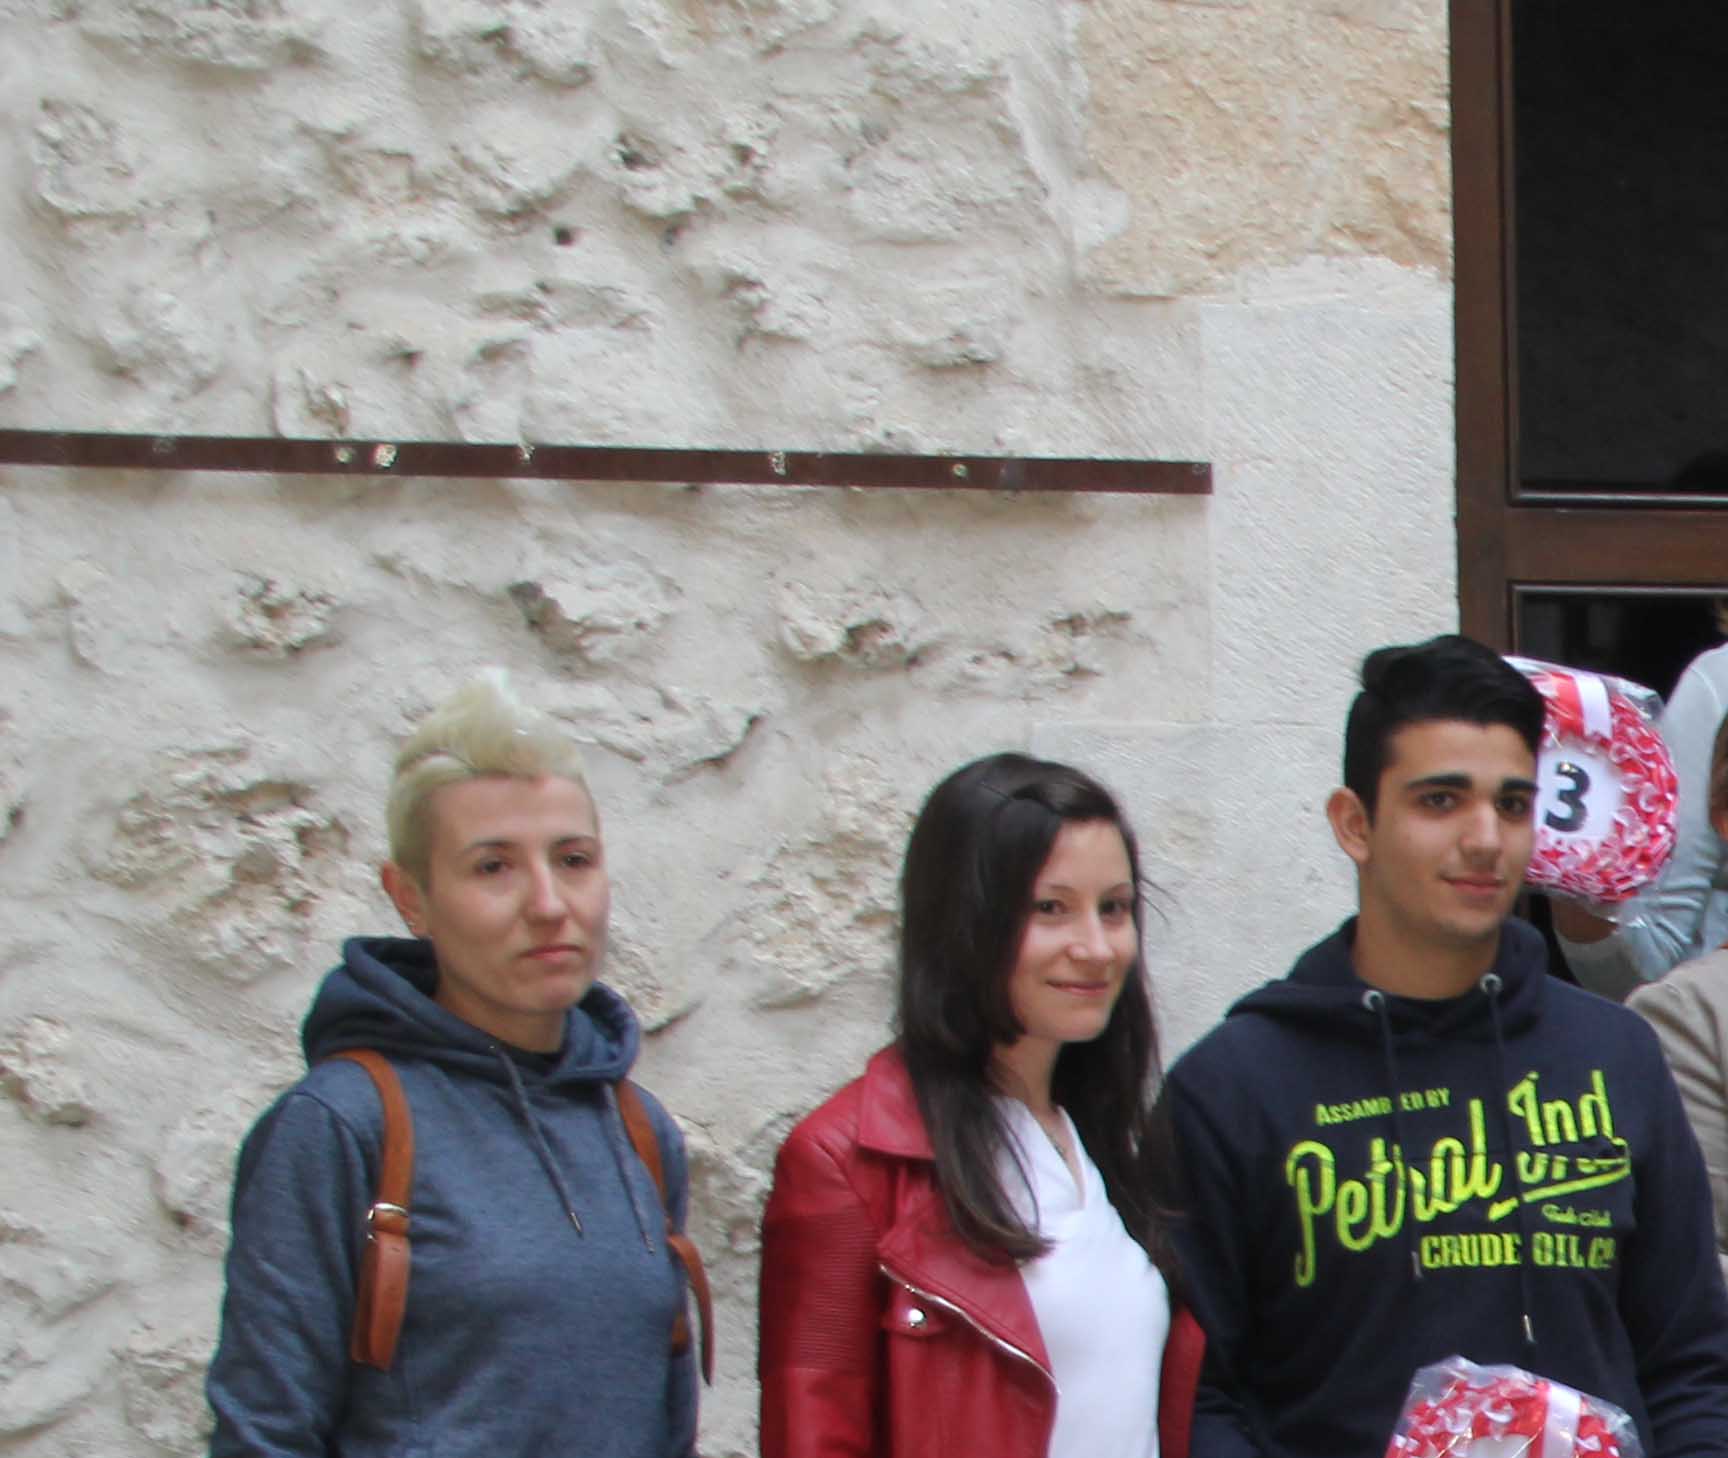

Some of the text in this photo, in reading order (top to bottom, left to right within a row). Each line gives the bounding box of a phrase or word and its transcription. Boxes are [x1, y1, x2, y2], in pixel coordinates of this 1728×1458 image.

[1545, 761, 1591, 833] 3
[1315, 1091, 1425, 1126] ASSAMBED
[1286, 1099, 1503, 1287] Petrol
[1421, 1232, 1522, 1269] CRUDE
